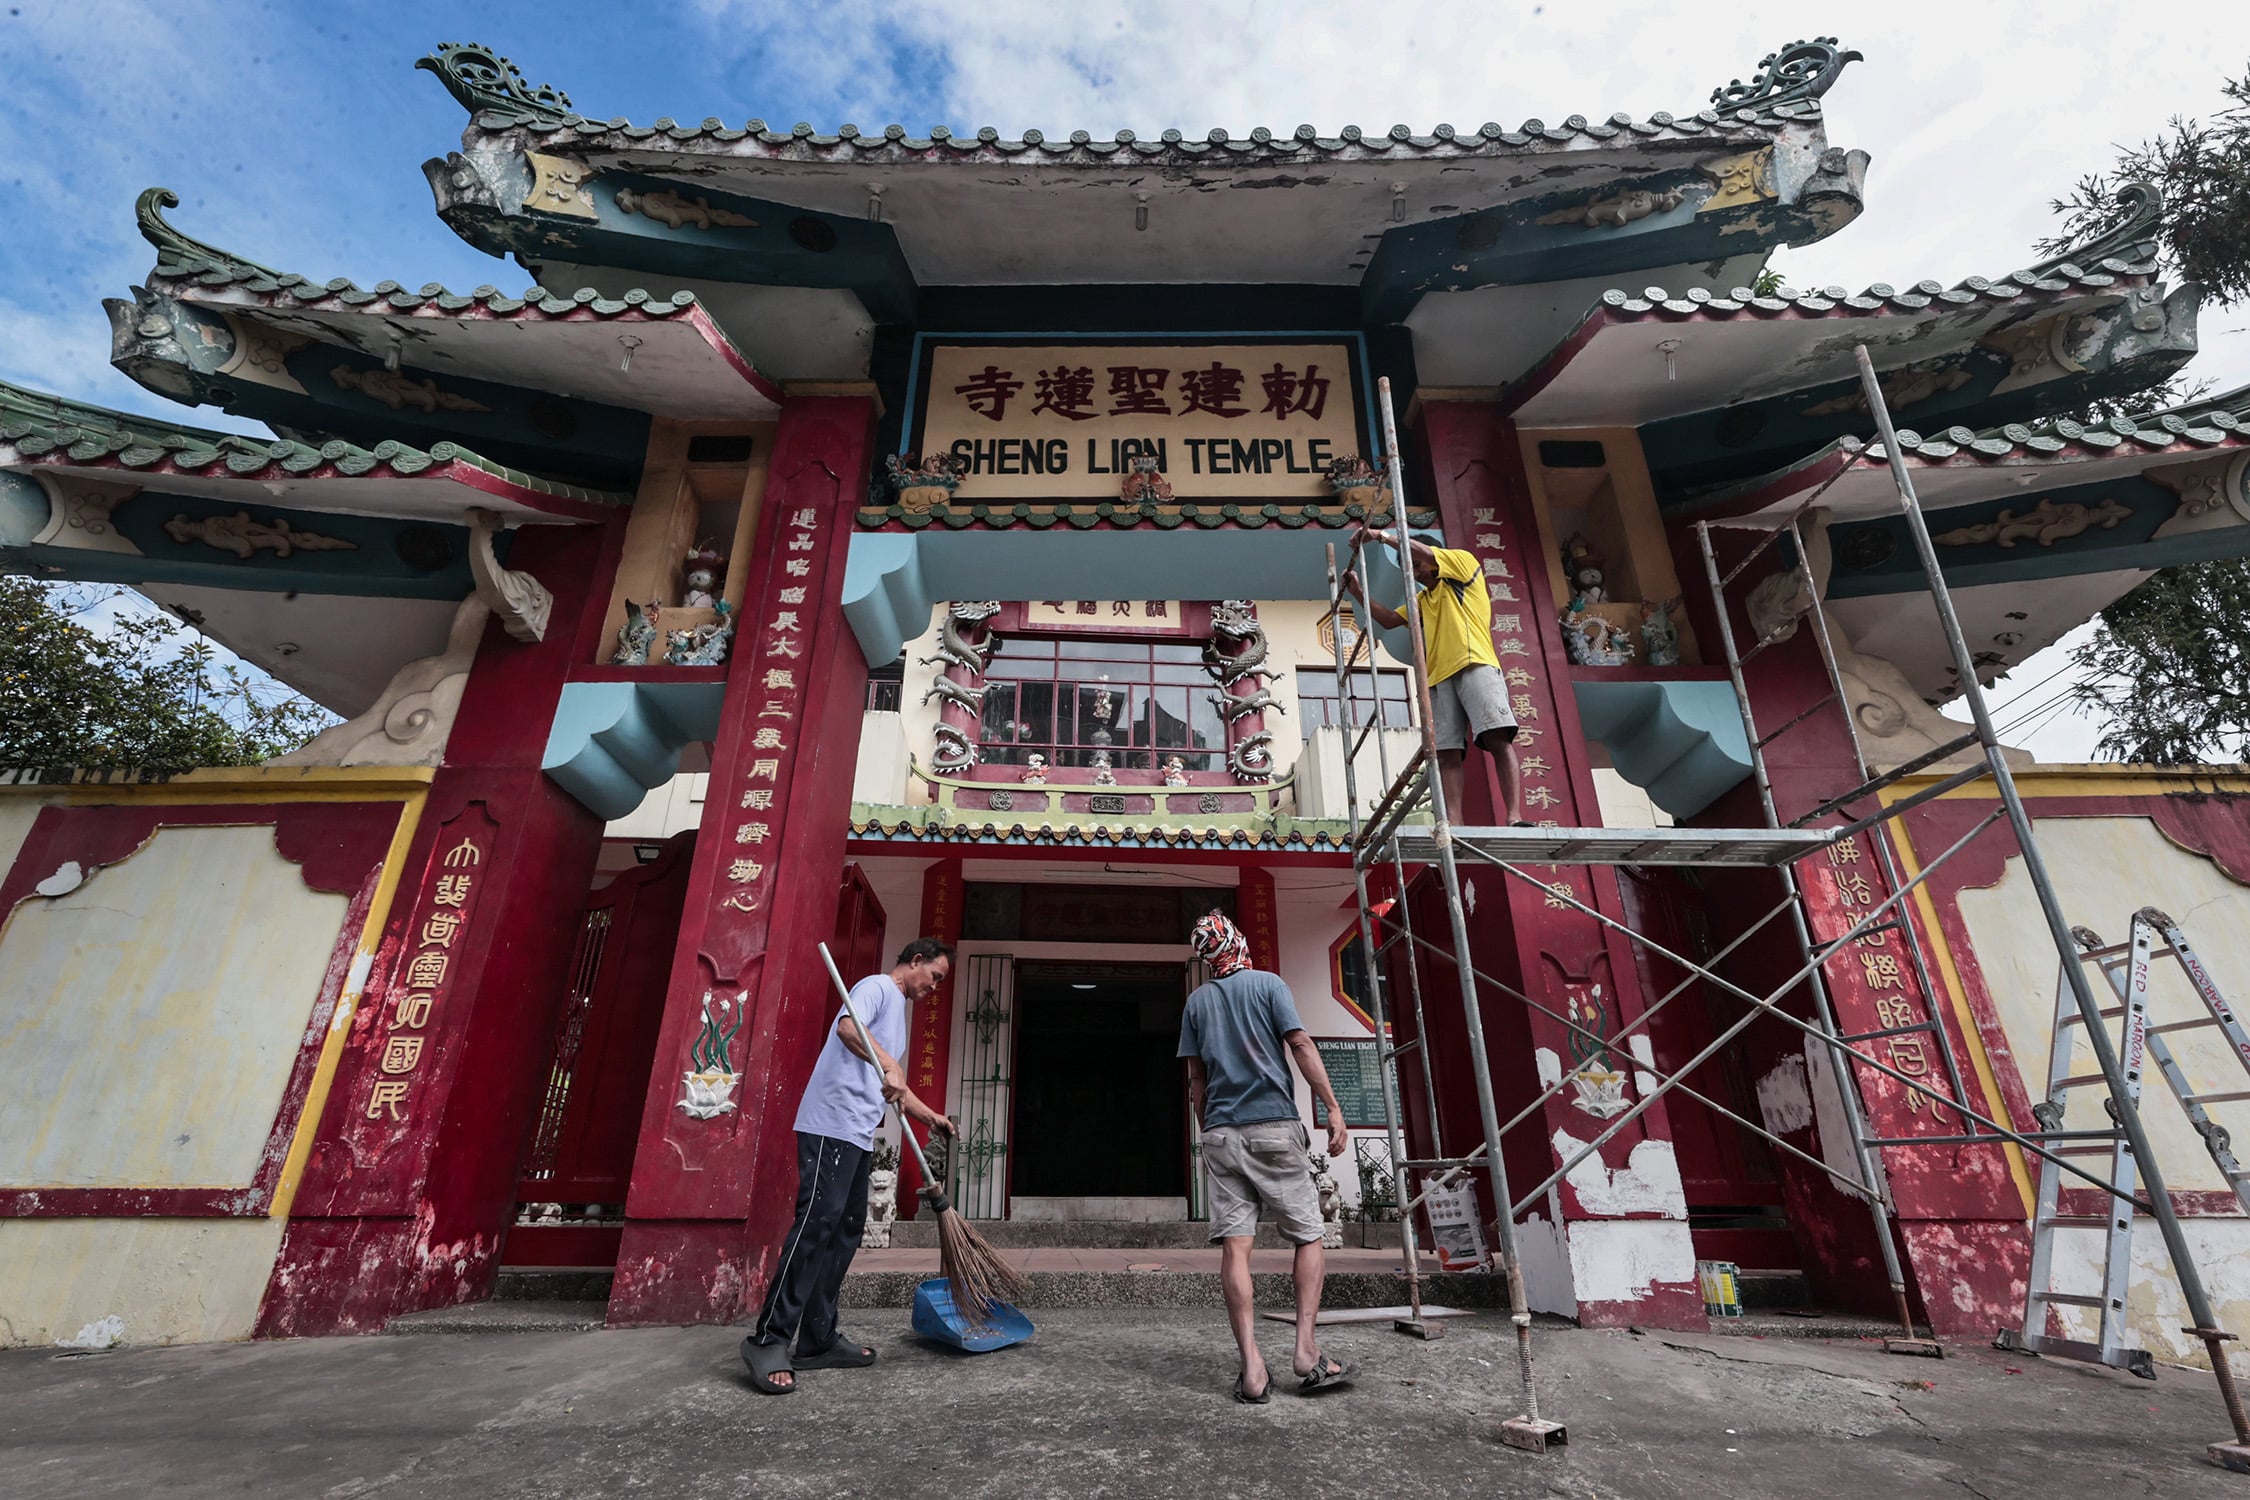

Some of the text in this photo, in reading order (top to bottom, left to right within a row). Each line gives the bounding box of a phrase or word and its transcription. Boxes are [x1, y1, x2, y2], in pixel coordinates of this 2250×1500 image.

[951, 439, 1068, 475] SHENG
[1183, 438, 1333, 475] TEMPLE
[2135, 960, 2148, 993] RED
[1317, 1041, 1340, 1050] SHENG
[1340, 1041, 1356, 1050] LIAN
